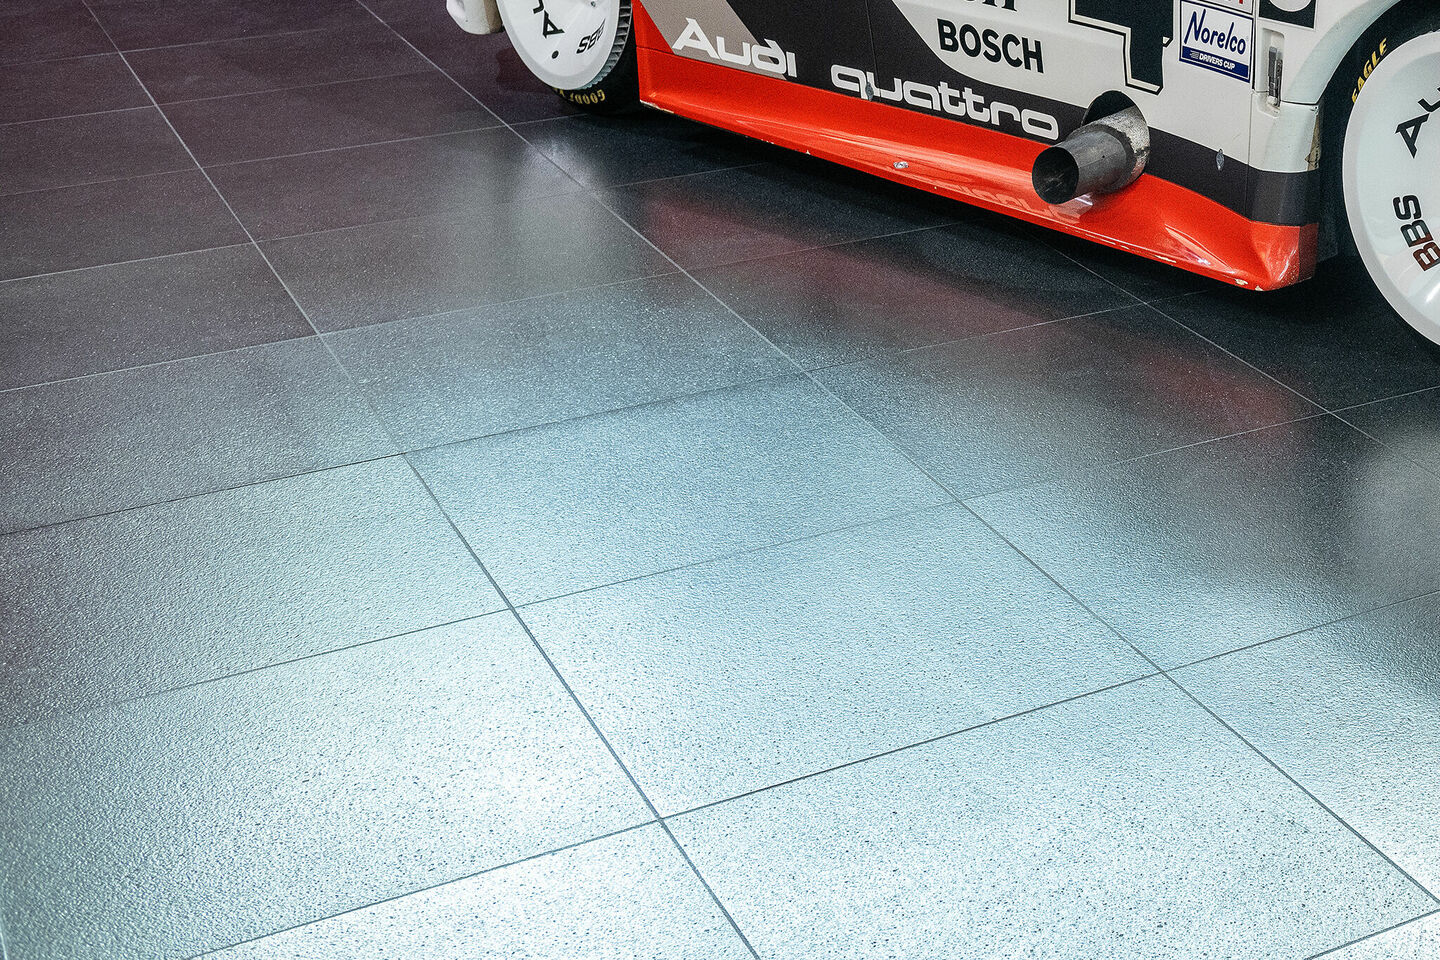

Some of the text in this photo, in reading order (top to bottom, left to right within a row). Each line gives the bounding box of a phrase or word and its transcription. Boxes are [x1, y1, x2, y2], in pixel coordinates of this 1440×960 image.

[937, 18, 1045, 74] BOSCH
[1184, 8, 1247, 55] Norelco
[672, 18, 1060, 141] Audi quattro
[1199, 52, 1236, 71] DRIVERS CUP
[1351, 37, 1388, 105] EAGLE
